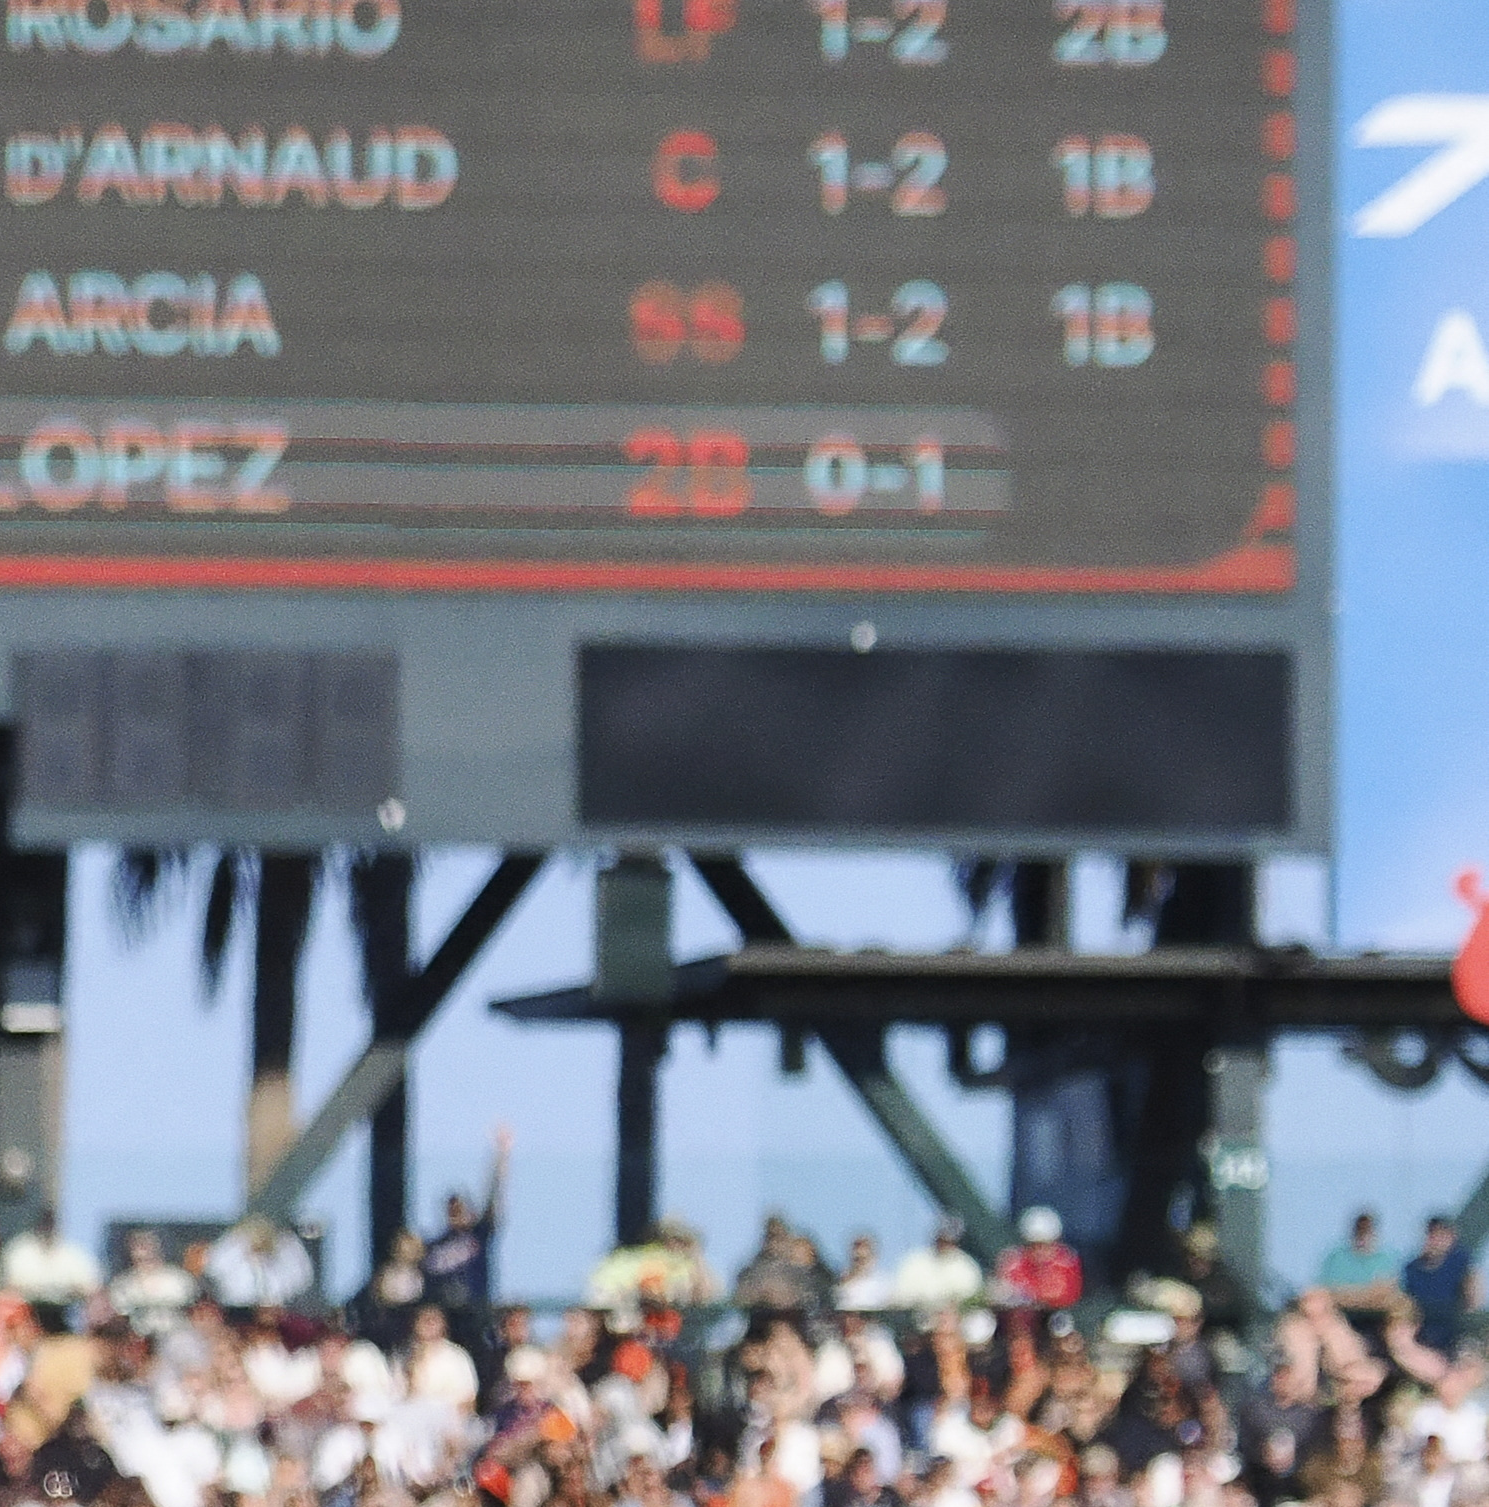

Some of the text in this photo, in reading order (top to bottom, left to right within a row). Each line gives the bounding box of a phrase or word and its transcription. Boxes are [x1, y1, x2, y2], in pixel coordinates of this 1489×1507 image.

[4, 122, 459, 210] D'ARNAUD
[653, 129, 720, 213] C
[809, 131, 949, 216] 1-2
[1053, 134, 1155, 219] 1B
[3, 268, 282, 358] ARCIA
[809, 279, 950, 366] 1-2
[1051, 281, 1155, 367] 1B
[625, 426, 752, 517] 2B
[804, 434, 946, 516] 0-1
